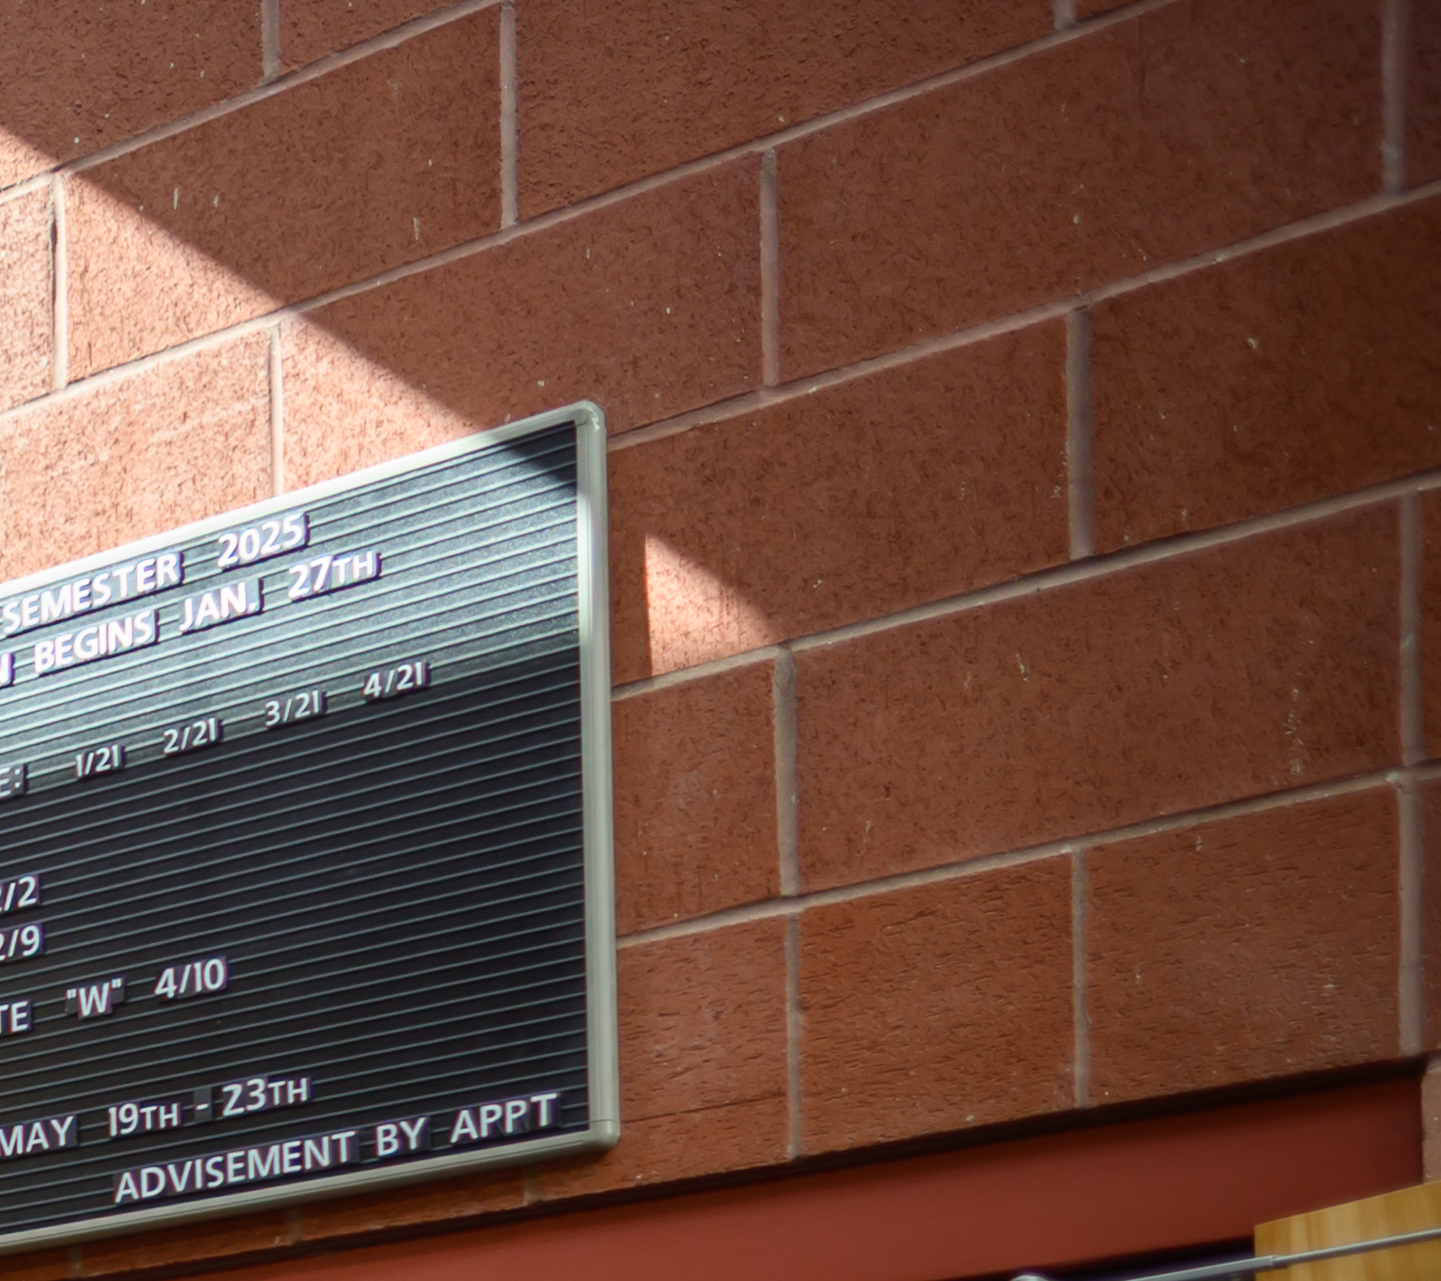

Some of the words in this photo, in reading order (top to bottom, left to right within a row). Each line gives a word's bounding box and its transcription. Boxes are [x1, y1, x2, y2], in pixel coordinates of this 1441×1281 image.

[1, 552, 182, 635] SEMESTER
[217, 513, 307, 569] 2025
[34, 609, 158, 674] BEGINS
[179, 580, 260, 633] JAN.
[287, 551, 378, 599] 27TH
[75, 744, 121, 777] 1/21
[163, 717, 220, 755] 2/21
[265, 690, 323, 727] 3/21
[363, 662, 427, 698] 4/21
[66, 978, 124, 1017] "W"
[155, 959, 225, 998] 4/10
[108, 1102, 179, 1137] 19TH
[115, 1131, 356, 1203] ADVISEMENT
[375, 1118, 427, 1157] BY
[450, 1093, 558, 1143] APPT
